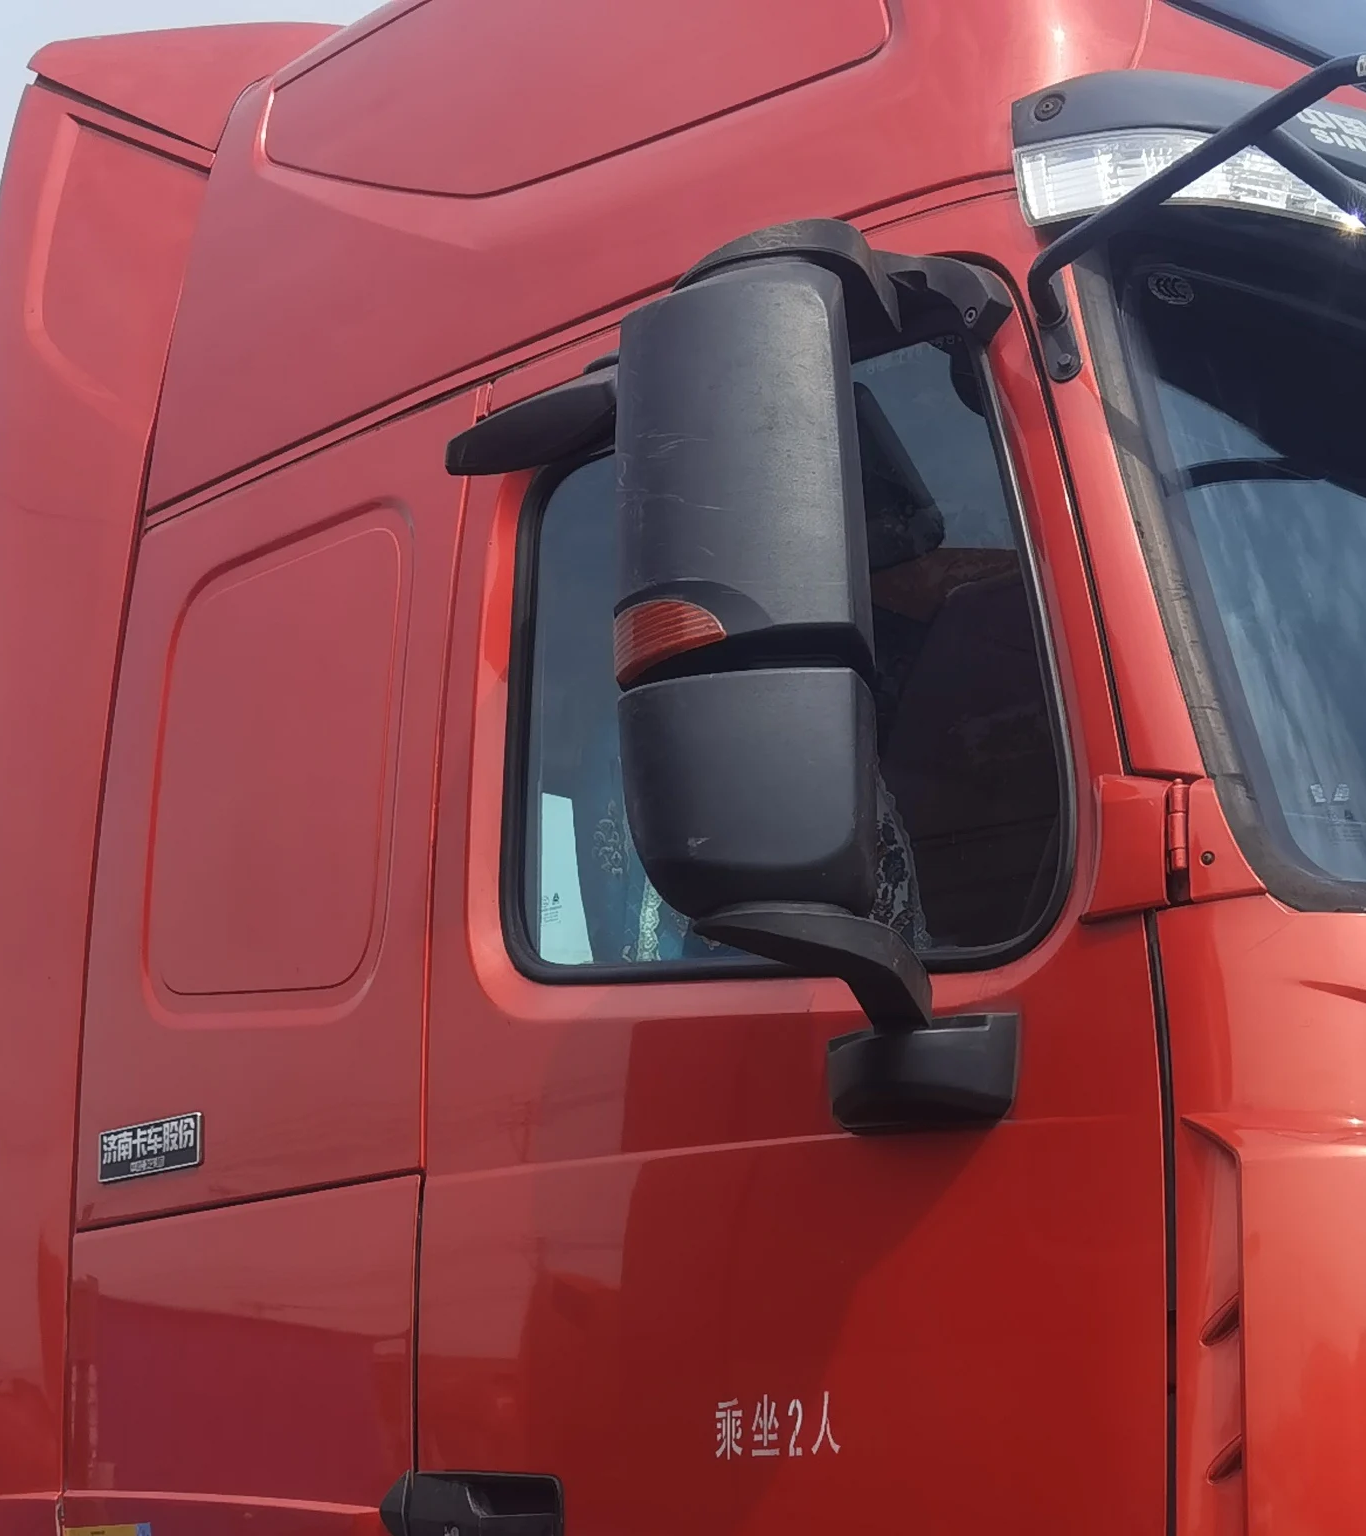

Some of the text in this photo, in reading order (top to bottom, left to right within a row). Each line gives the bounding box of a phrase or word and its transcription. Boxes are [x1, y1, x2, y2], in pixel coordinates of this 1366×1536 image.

[102, 1117, 196, 1165] 济南卡车股份
[715, 1390, 841, 1461] 乘坐2人
